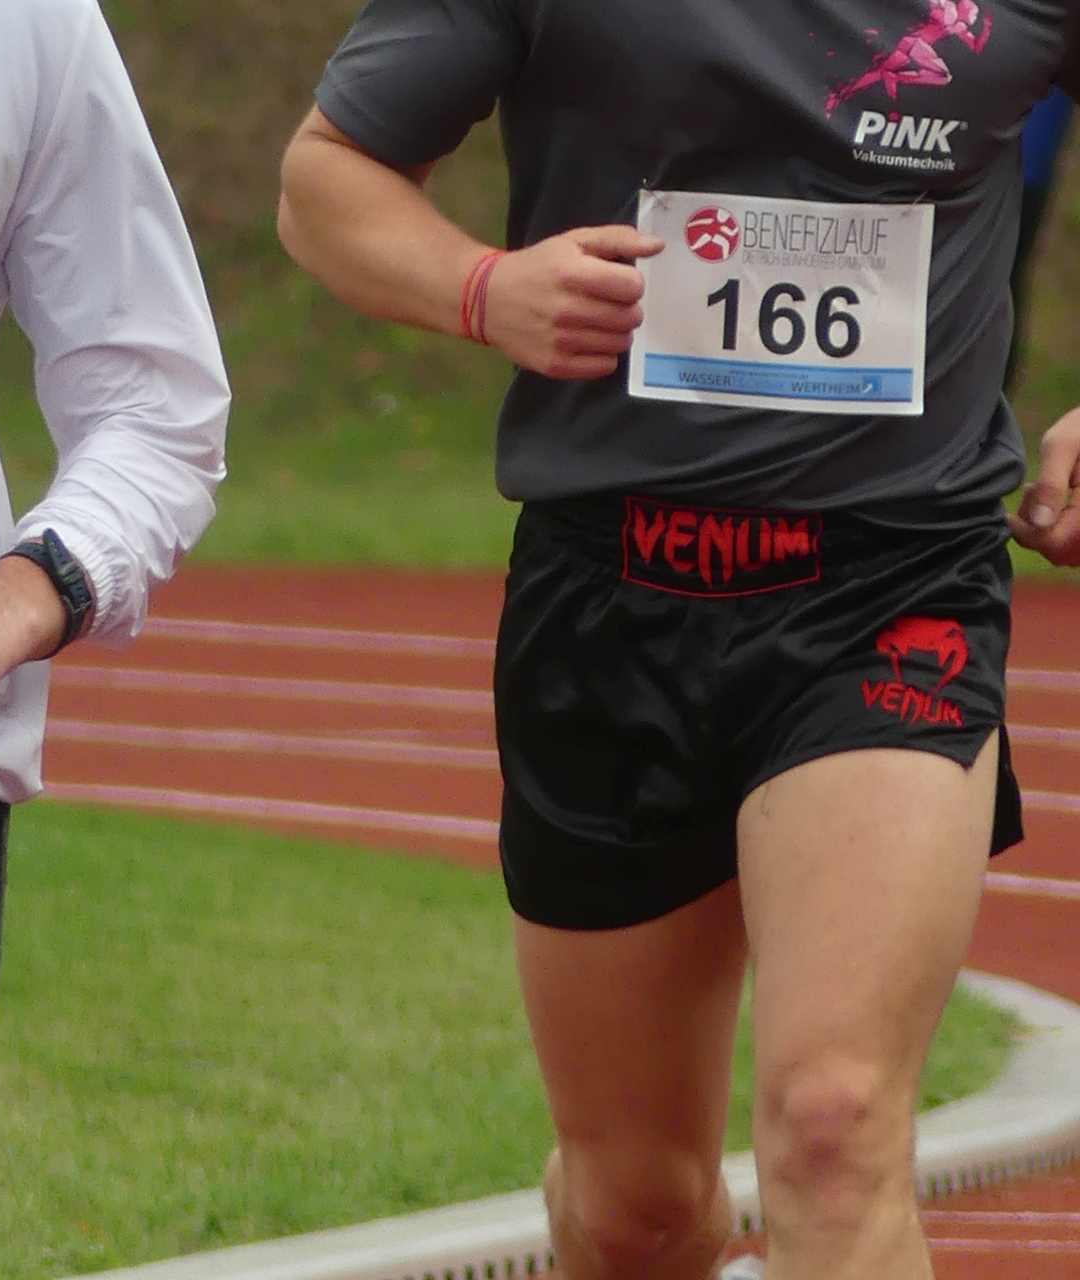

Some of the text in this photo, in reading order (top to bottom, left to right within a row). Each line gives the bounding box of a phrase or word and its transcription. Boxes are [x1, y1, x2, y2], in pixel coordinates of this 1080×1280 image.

[852, 148, 956, 171] Vakuumtechnik
[744, 210, 889, 255] BENEFIZLAUF
[707, 279, 861, 358] 166
[861, 678, 964, 728] VENUM
